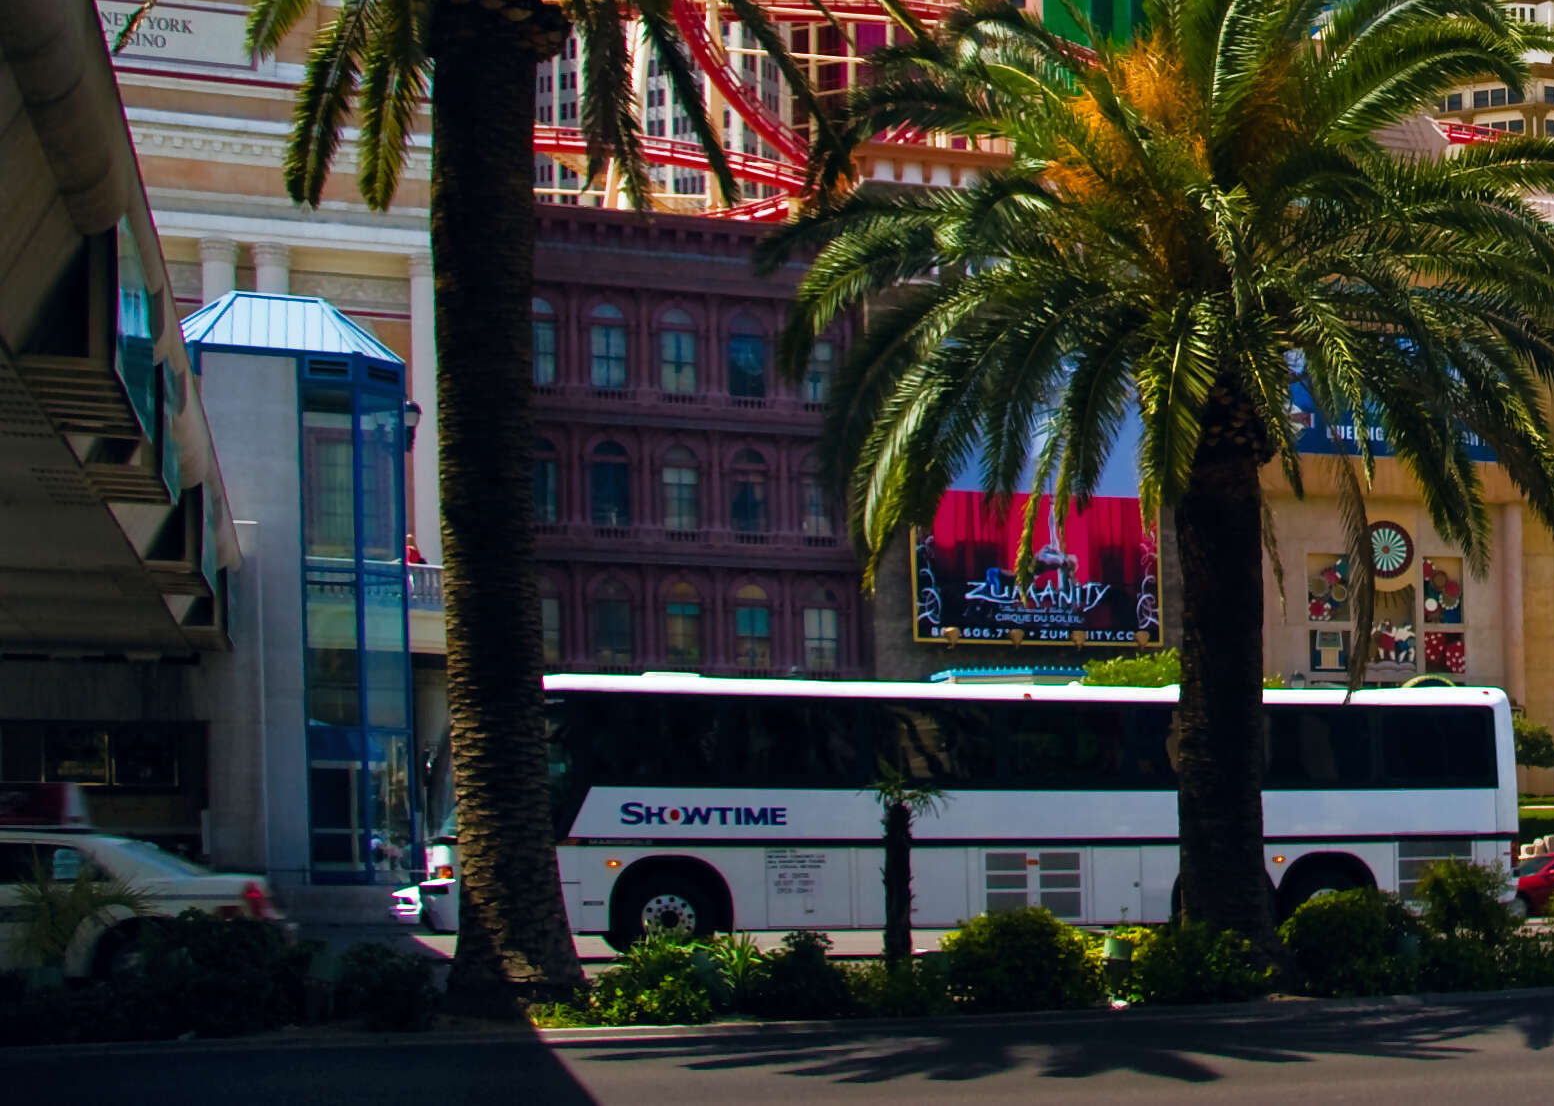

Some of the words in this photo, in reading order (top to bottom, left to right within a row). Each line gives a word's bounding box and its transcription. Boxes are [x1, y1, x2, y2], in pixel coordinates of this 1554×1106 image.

[101, 11, 134, 27] NE
[147, 16, 193, 34] YORK
[105, 28, 167, 48] CSINO
[995, 612, 1032, 624] CIRQUE
[1033, 613, 1048, 623] DU
[620, 802, 788, 826] SHOWTIME
